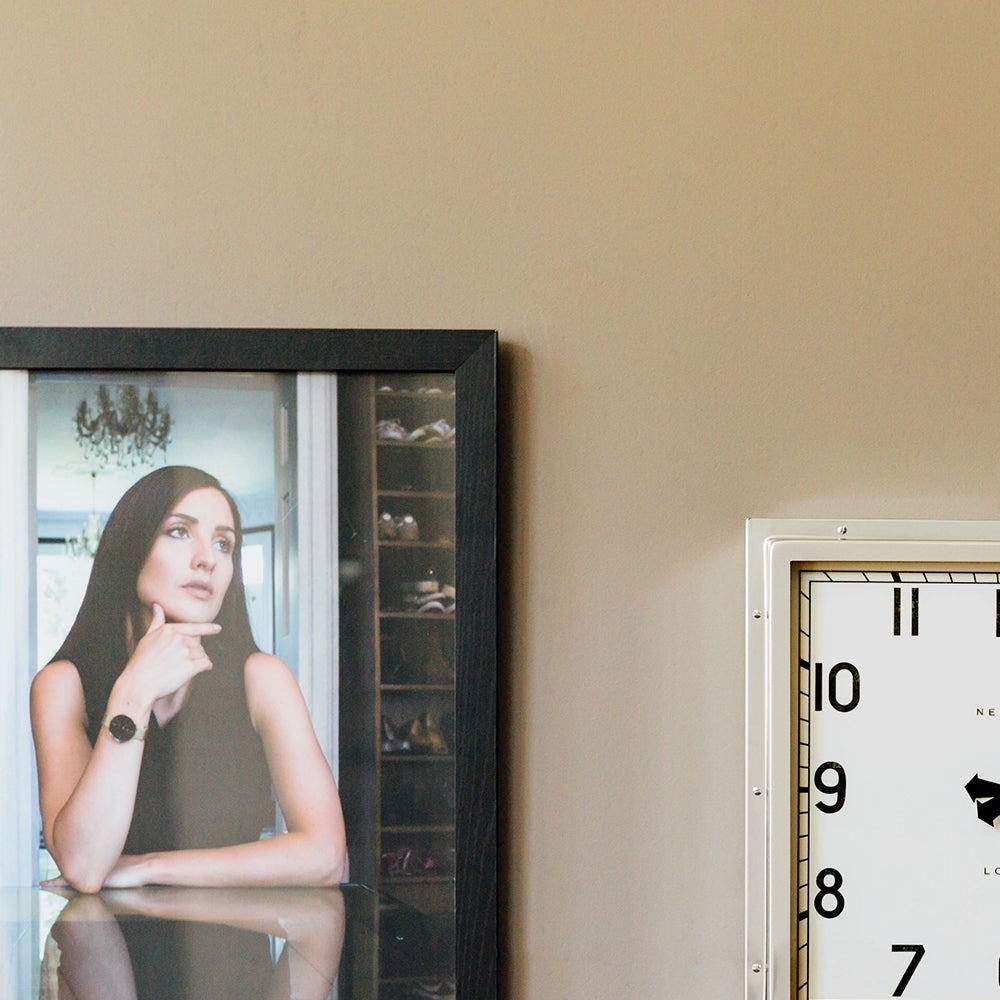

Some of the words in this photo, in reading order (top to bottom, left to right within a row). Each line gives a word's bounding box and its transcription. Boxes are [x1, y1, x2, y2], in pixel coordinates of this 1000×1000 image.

[893, 587, 920, 637] 11
[814, 661, 861, 713] 10
[813, 761, 847, 814] 9
[813, 867, 845, 919] 8
[891, 944, 926, 998] 7
